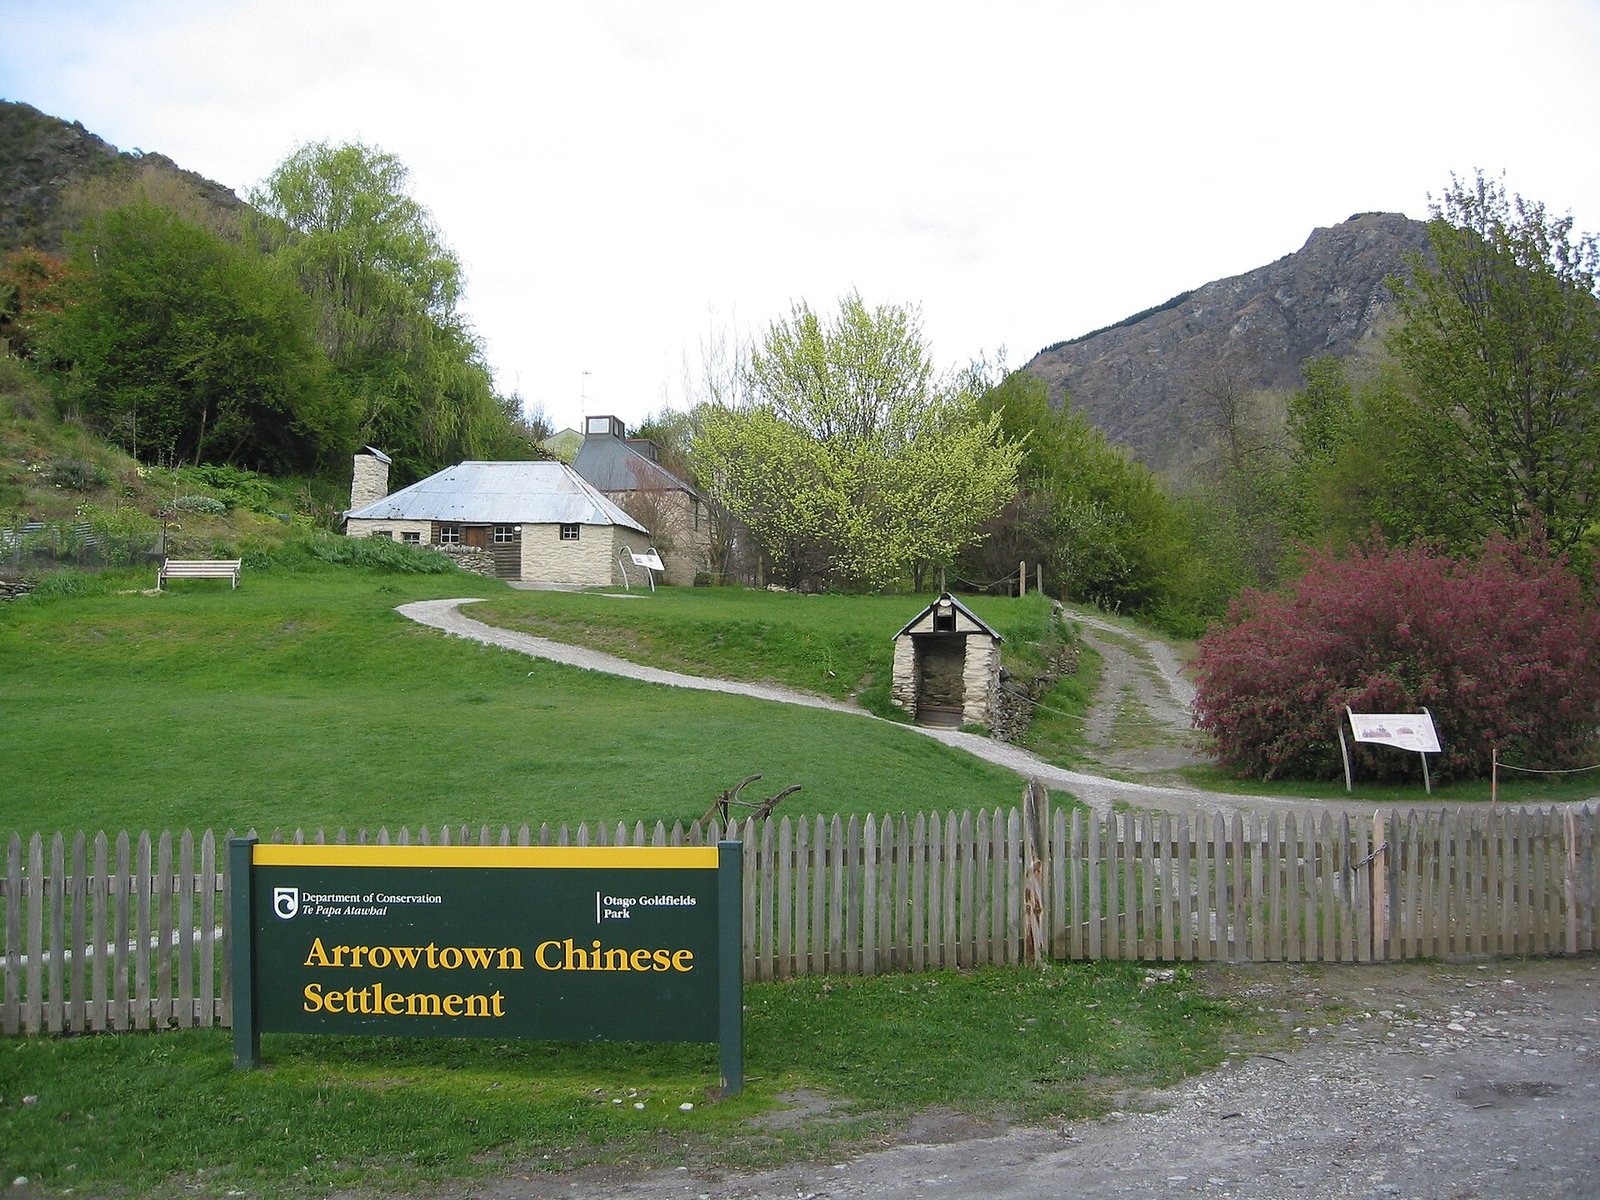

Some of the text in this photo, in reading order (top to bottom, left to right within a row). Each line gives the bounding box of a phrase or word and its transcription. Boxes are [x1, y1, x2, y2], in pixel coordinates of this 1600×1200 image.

[302, 892, 442, 905] Department of Conservation
[603, 895, 697, 909] Otago Goldfields
[302, 904, 314, 915] Te
[315, 905, 342, 918] Papa
[603, 908, 631, 919] Park
[303, 937, 695, 972] Arrowtown Chinese
[302, 982, 506, 1018] Settlement
